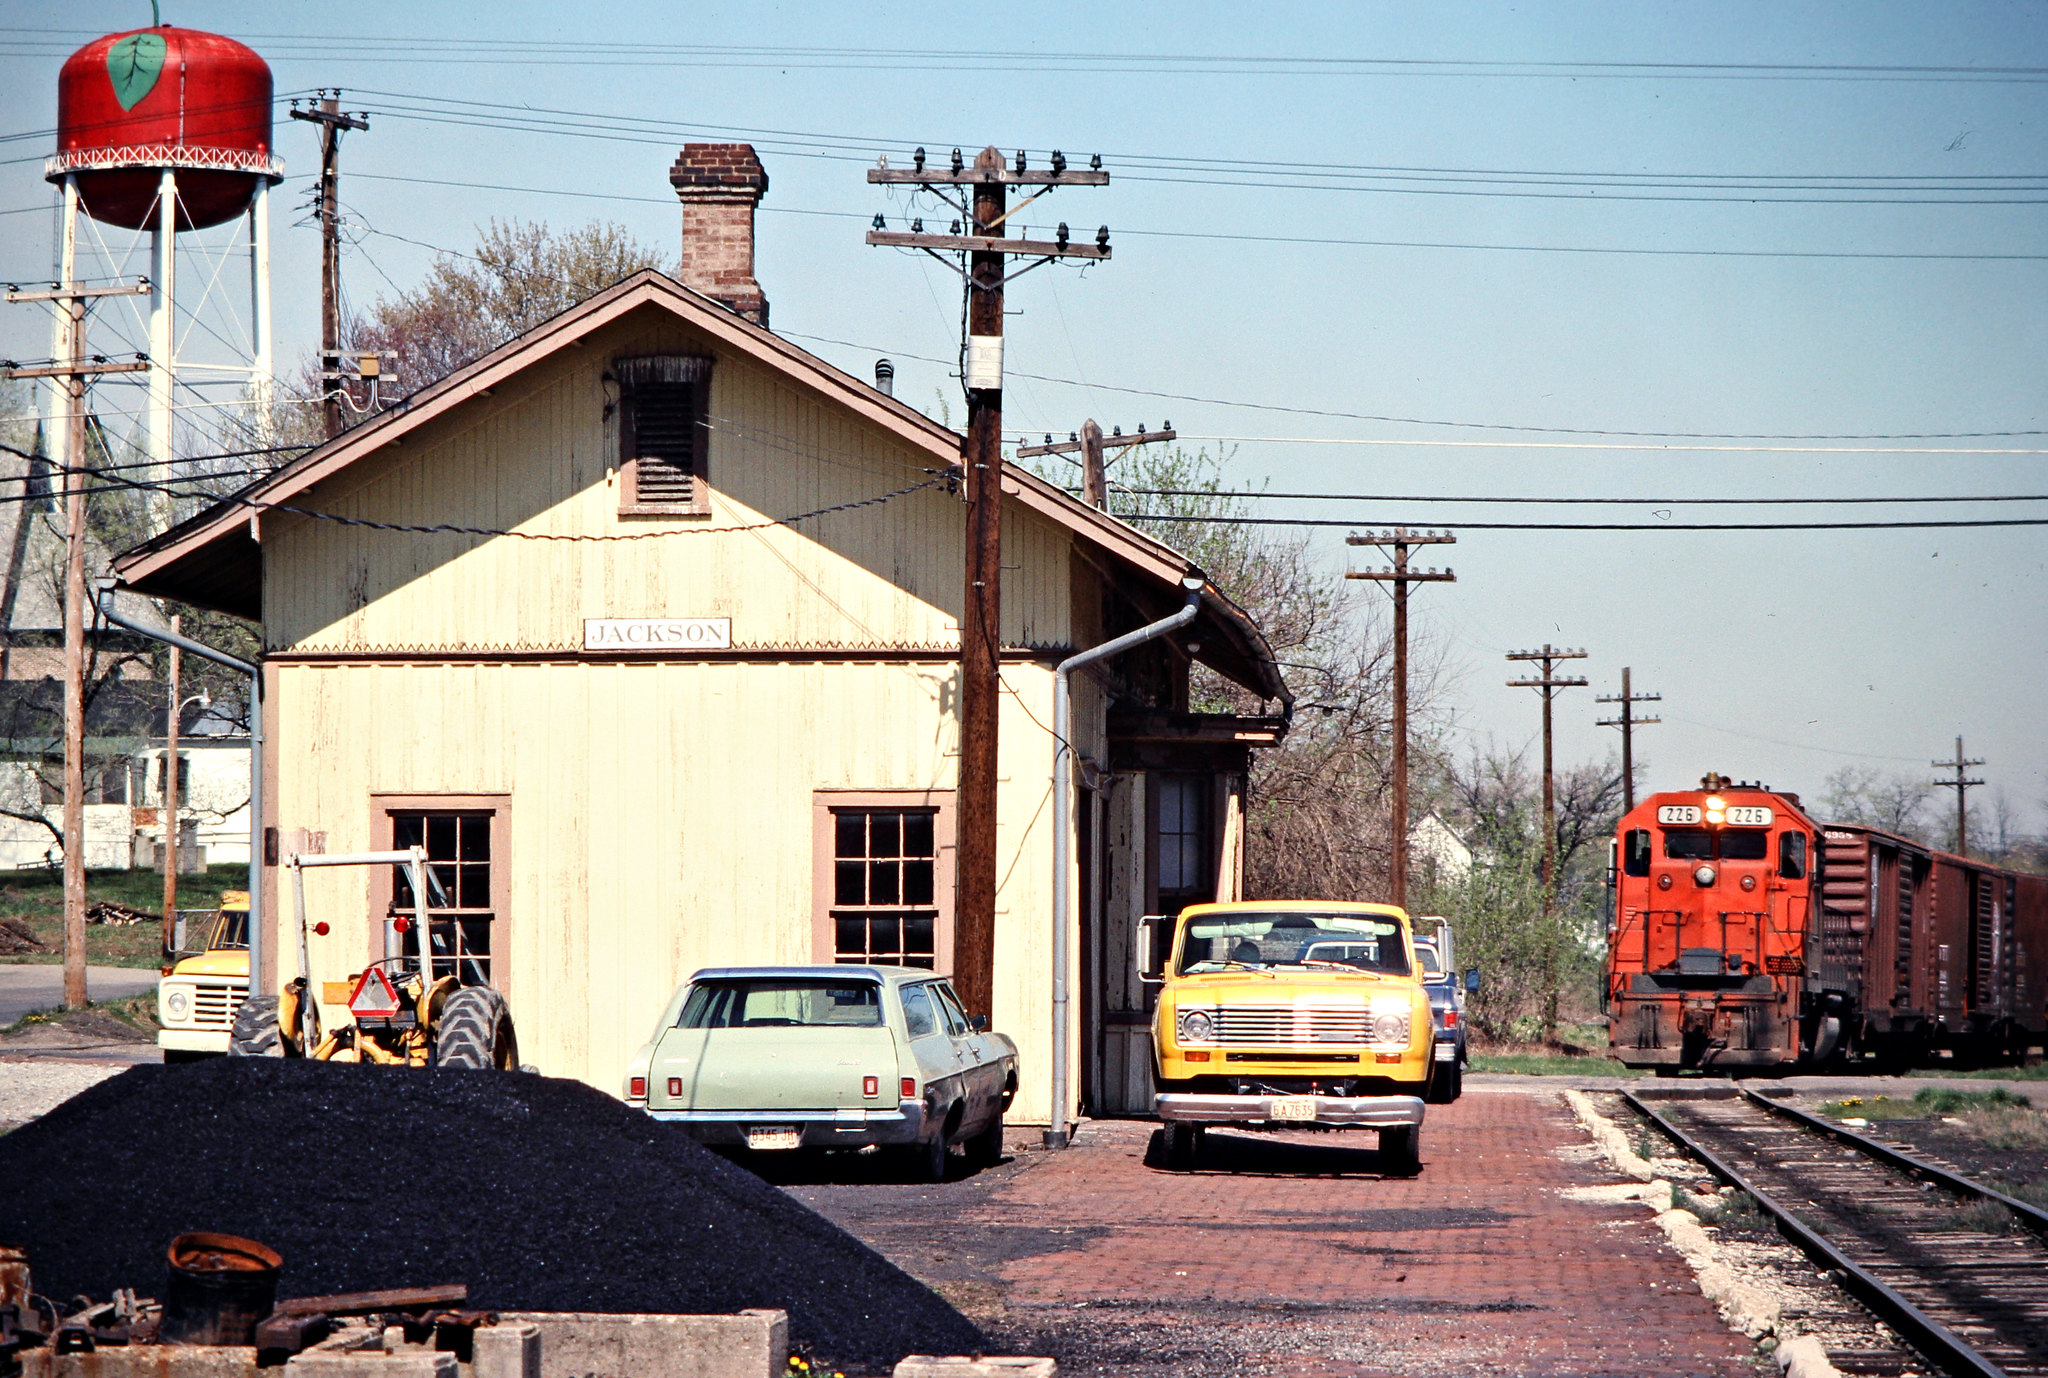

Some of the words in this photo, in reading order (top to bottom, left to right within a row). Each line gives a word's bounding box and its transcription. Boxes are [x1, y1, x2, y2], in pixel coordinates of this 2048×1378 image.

[591, 624, 723, 643] JACKSON
[1666, 807, 1693, 822] 226
[1734, 808, 1763, 823] 226
